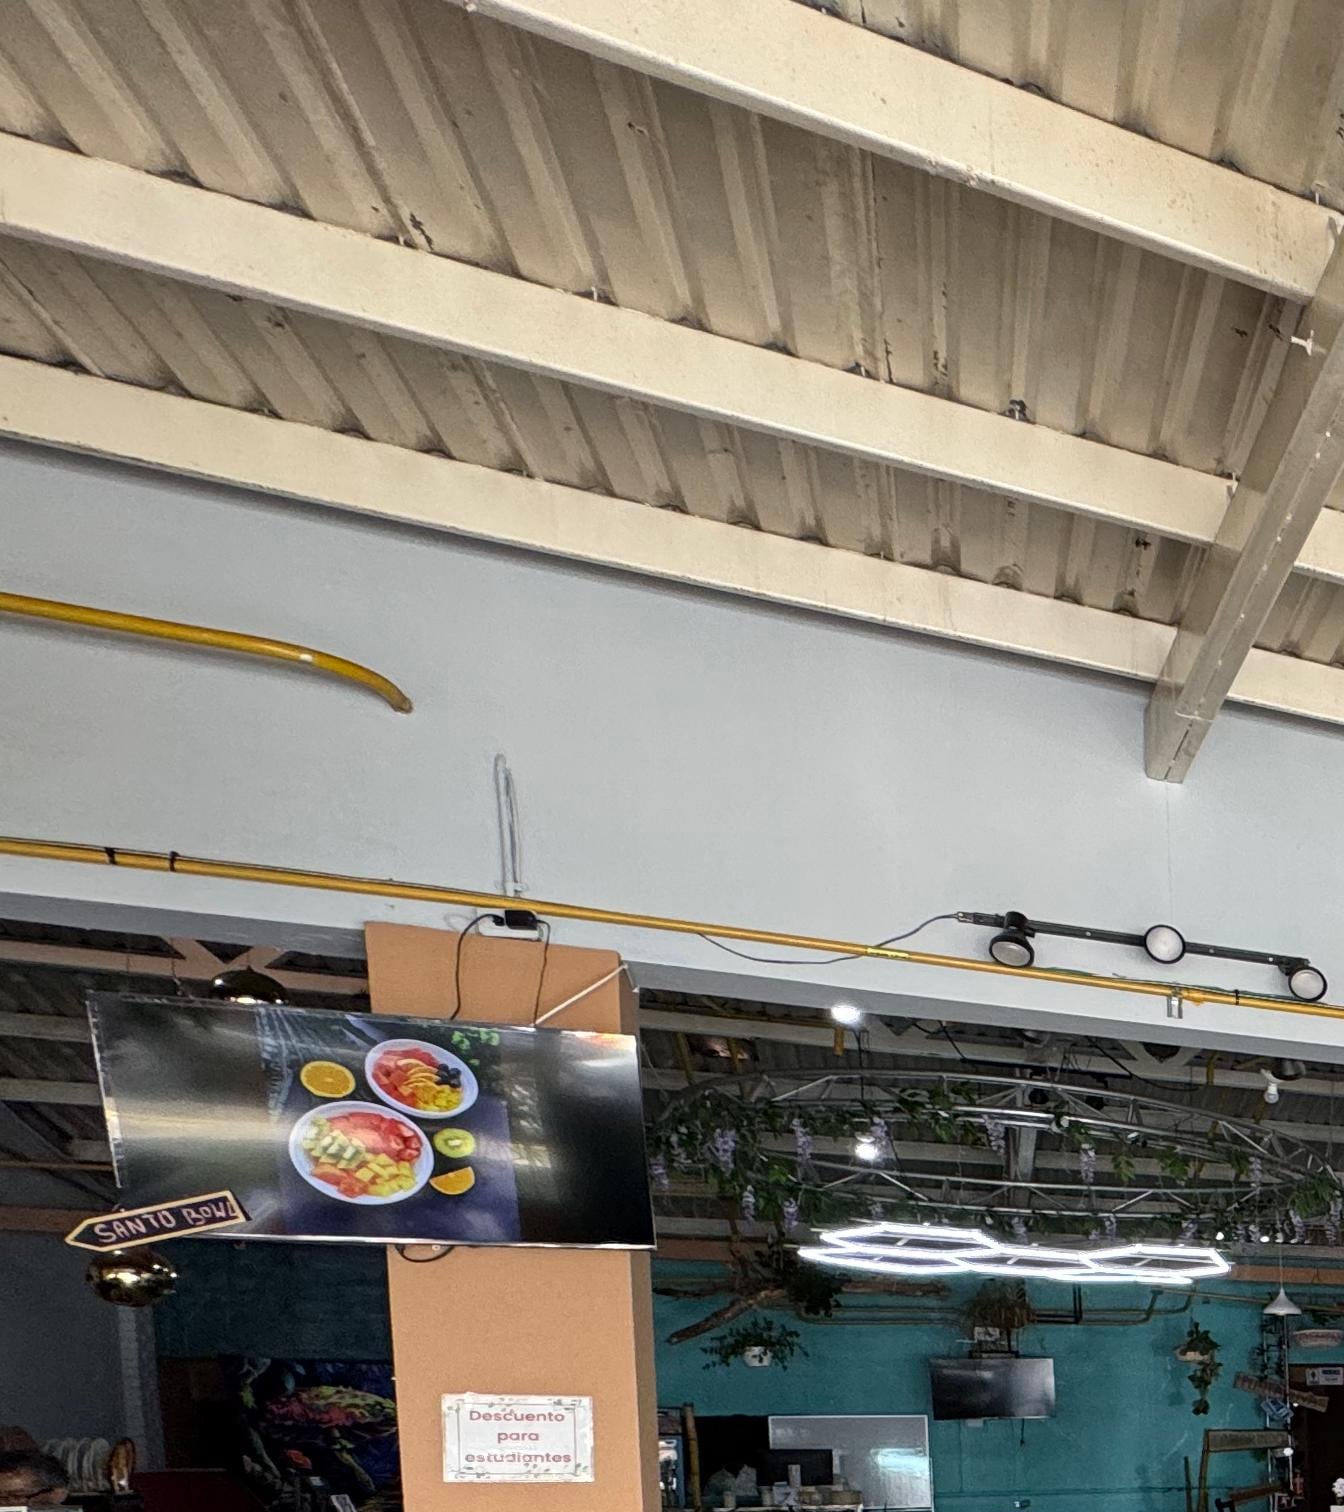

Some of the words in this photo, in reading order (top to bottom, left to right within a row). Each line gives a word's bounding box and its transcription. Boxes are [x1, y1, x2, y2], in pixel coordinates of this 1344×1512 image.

[94, 1211, 175, 1243] SANTO
[469, 1410, 565, 1422] Descuento
[497, 1432, 540, 1443] para
[464, 1452, 572, 1463] estudiantes
